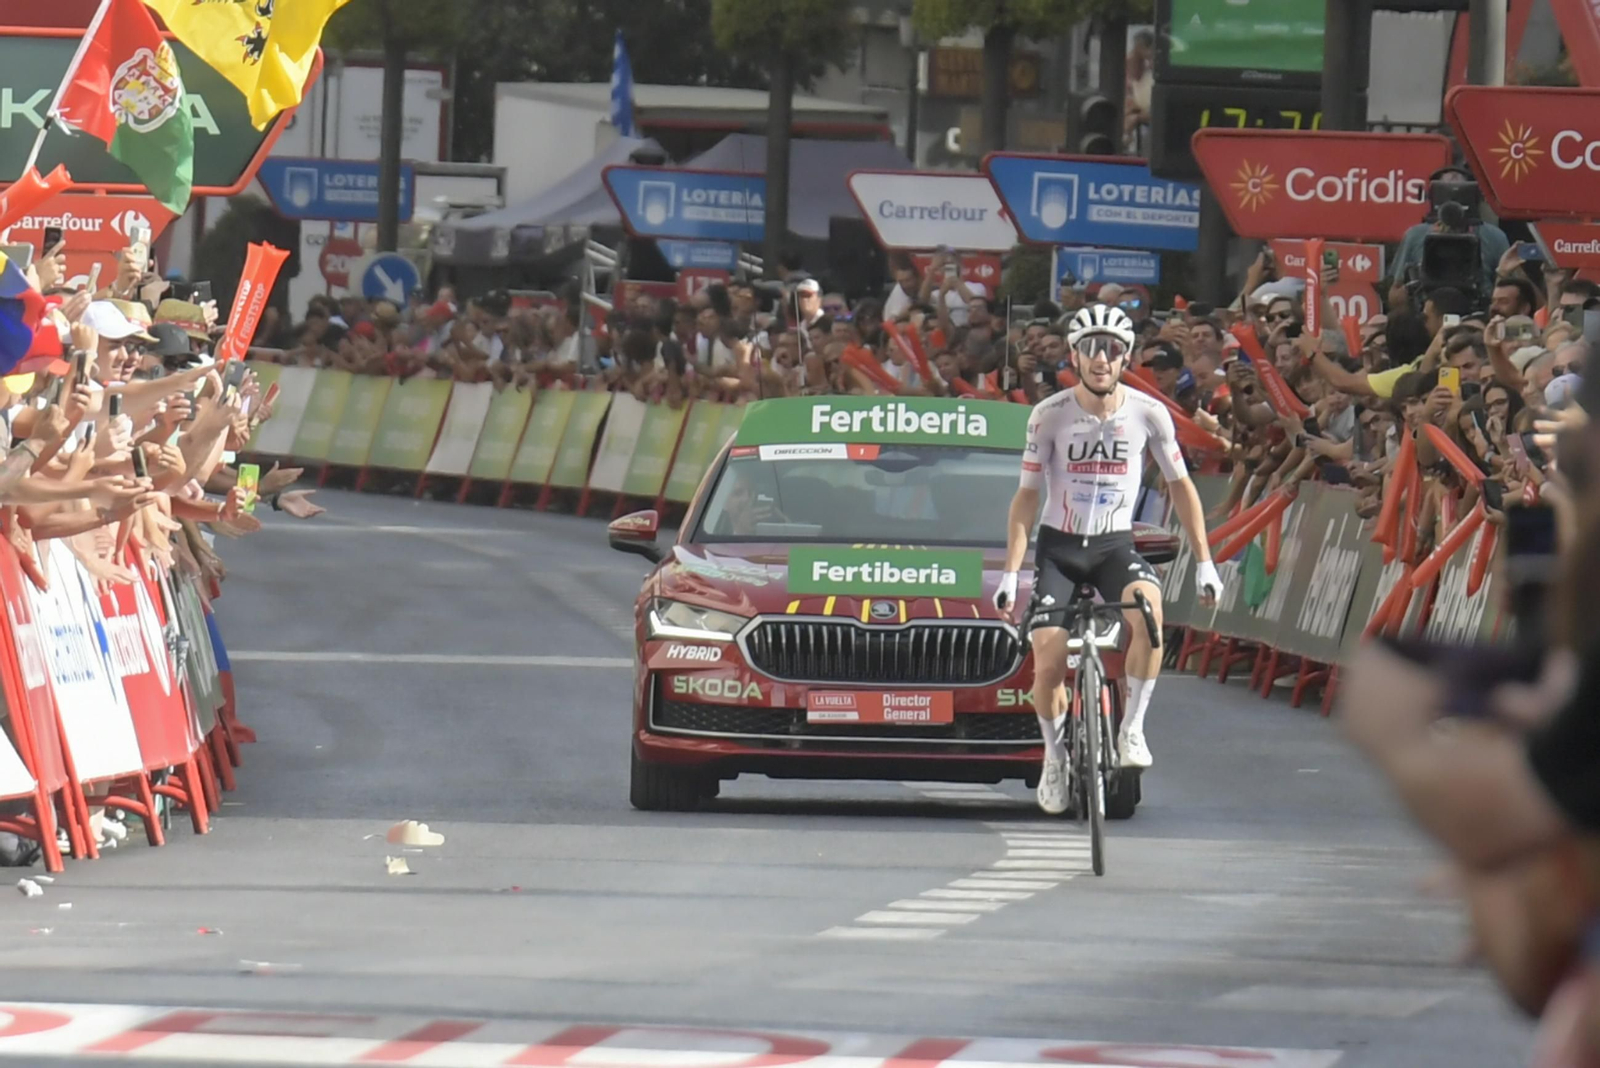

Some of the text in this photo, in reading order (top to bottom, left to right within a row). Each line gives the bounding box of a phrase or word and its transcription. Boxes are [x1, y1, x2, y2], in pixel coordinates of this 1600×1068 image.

[1285, 167, 1426, 204] Cofidis
[879, 199, 989, 221] Carrefour
[1141, 210, 1196, 224] DEPORTE
[812, 403, 987, 436] Fertiberia
[1068, 440, 1129, 462] UAE
[812, 561, 957, 585] Fertiberia
[666, 645, 722, 662] HYBRID
[815, 696, 853, 706] LA VUELTA
[883, 693, 932, 707] Director
[883, 707, 931, 721] General
